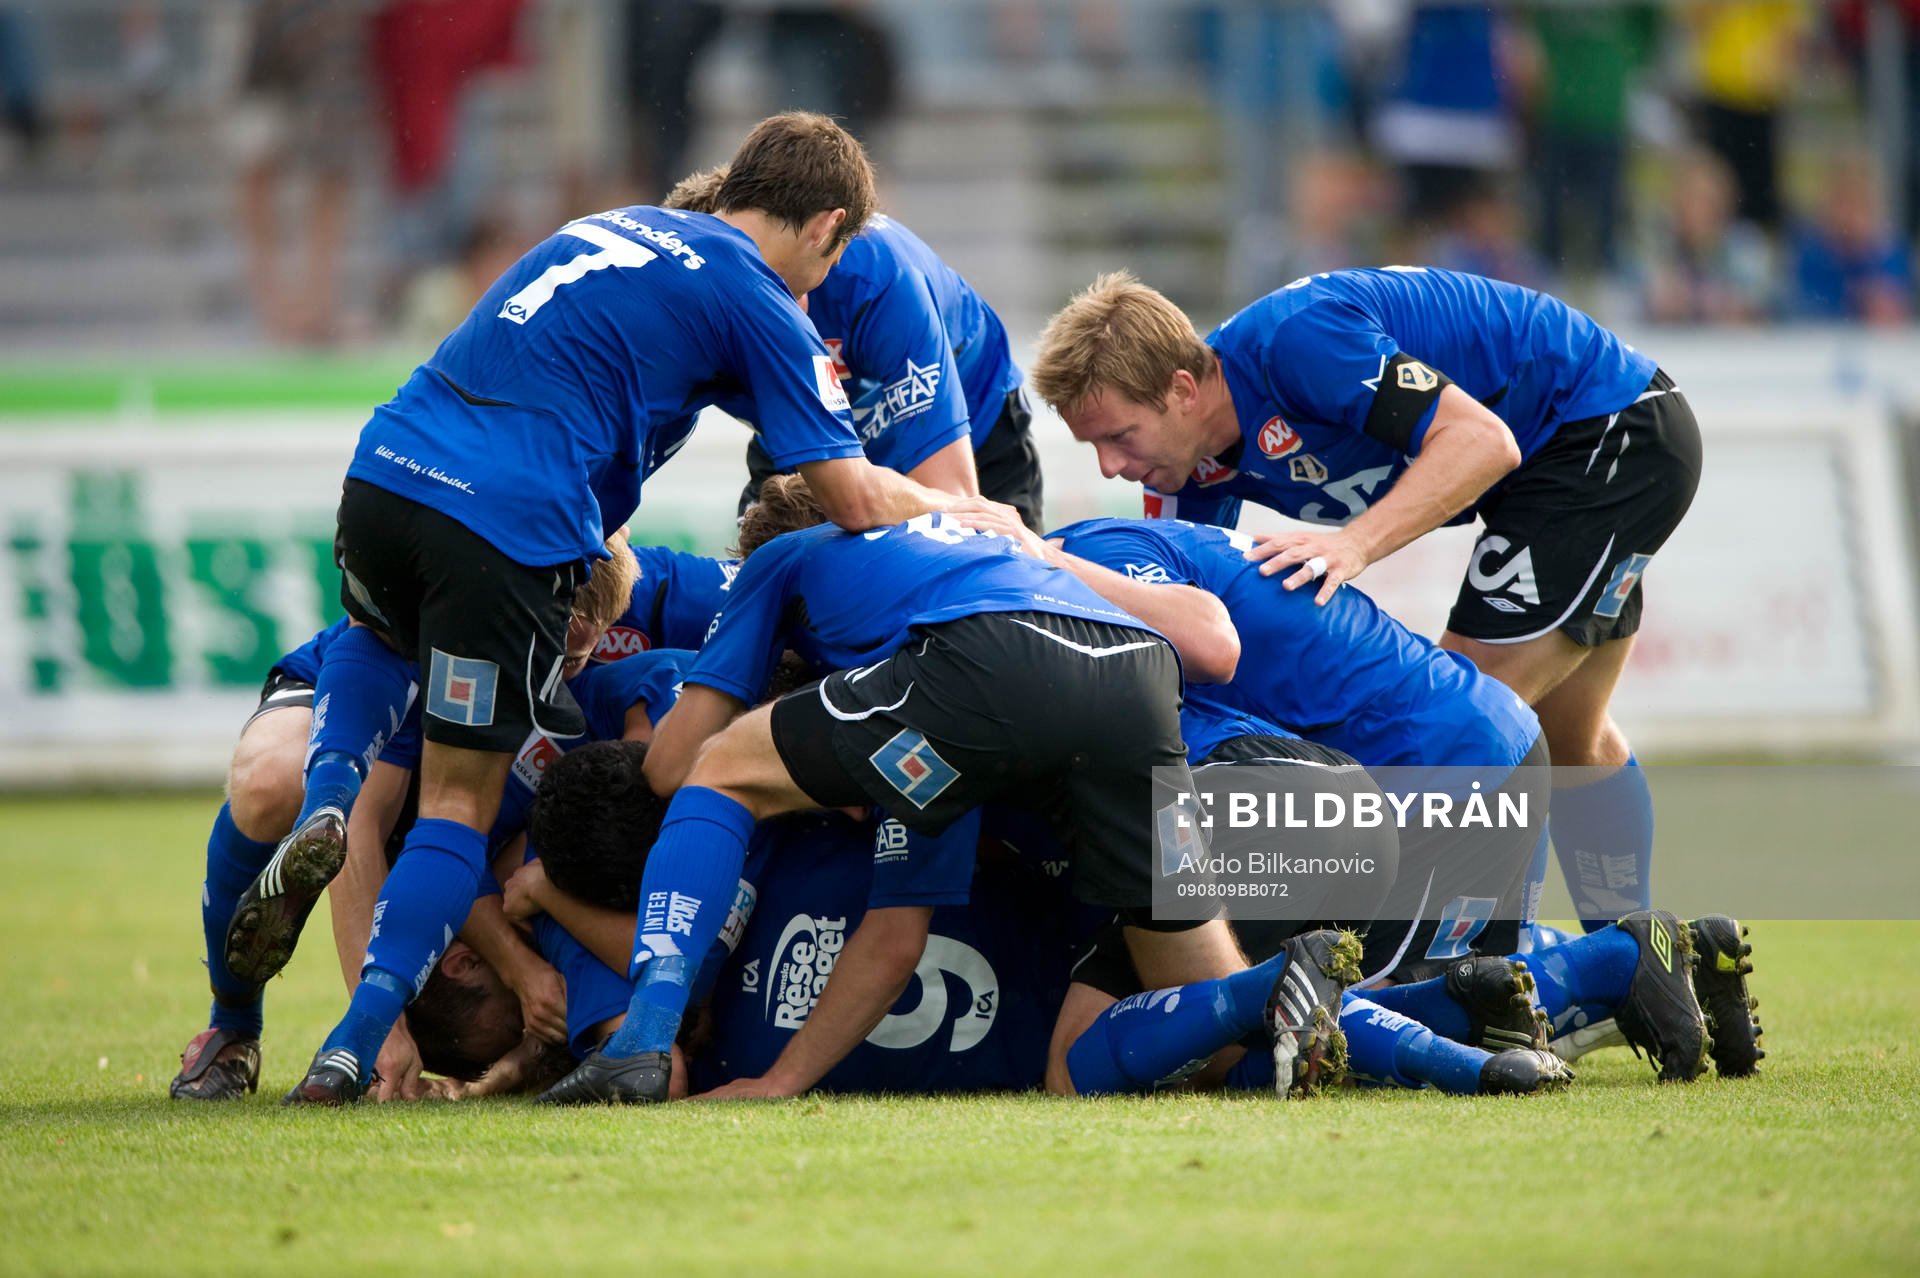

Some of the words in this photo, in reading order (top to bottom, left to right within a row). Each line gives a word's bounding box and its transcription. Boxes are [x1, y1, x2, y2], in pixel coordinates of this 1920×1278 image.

[497, 223, 658, 325] 7
[504, 301, 527, 320] ICA
[1469, 535, 1540, 605] CA
[595, 631, 645, 654] AXA
[642, 891, 668, 932] INTER
[666, 891, 702, 937] SPORT
[742, 959, 760, 993] ICA
[774, 941, 817, 1030] Rese
[777, 963, 790, 1001] Svenska
[975, 990, 995, 1019] ICA
